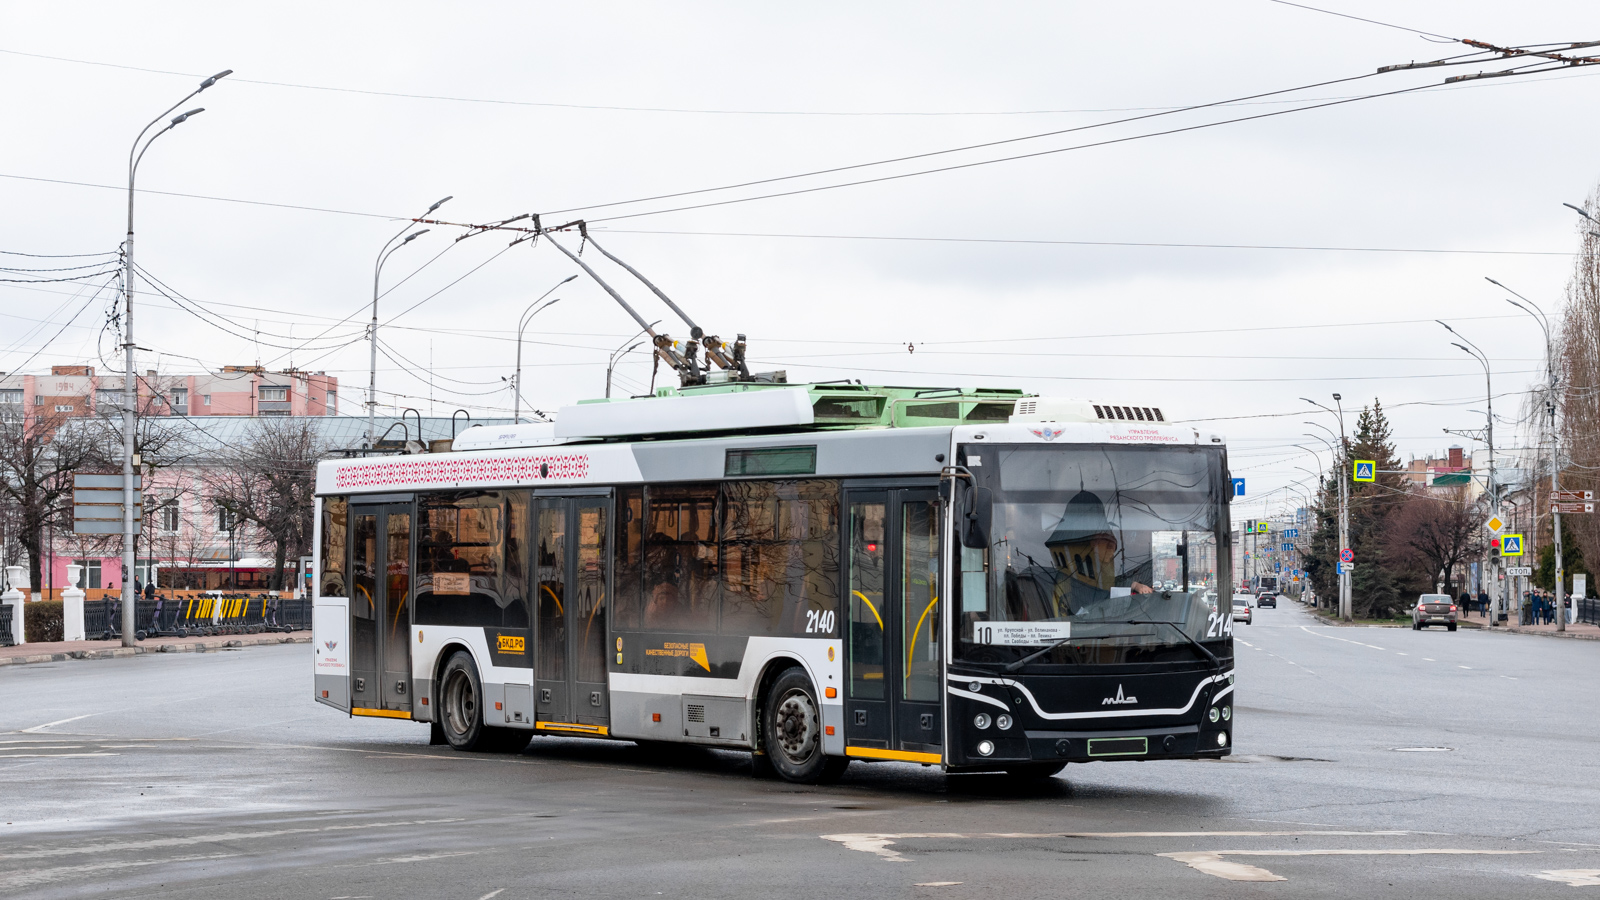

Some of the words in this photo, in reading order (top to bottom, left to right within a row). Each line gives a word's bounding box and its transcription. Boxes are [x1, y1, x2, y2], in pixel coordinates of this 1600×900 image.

[55, 382, 74, 391] 1984
[805, 609, 835, 634] 2140
[502, 637, 524, 649] БКД.РФ
[977, 626, 992, 645] 10
